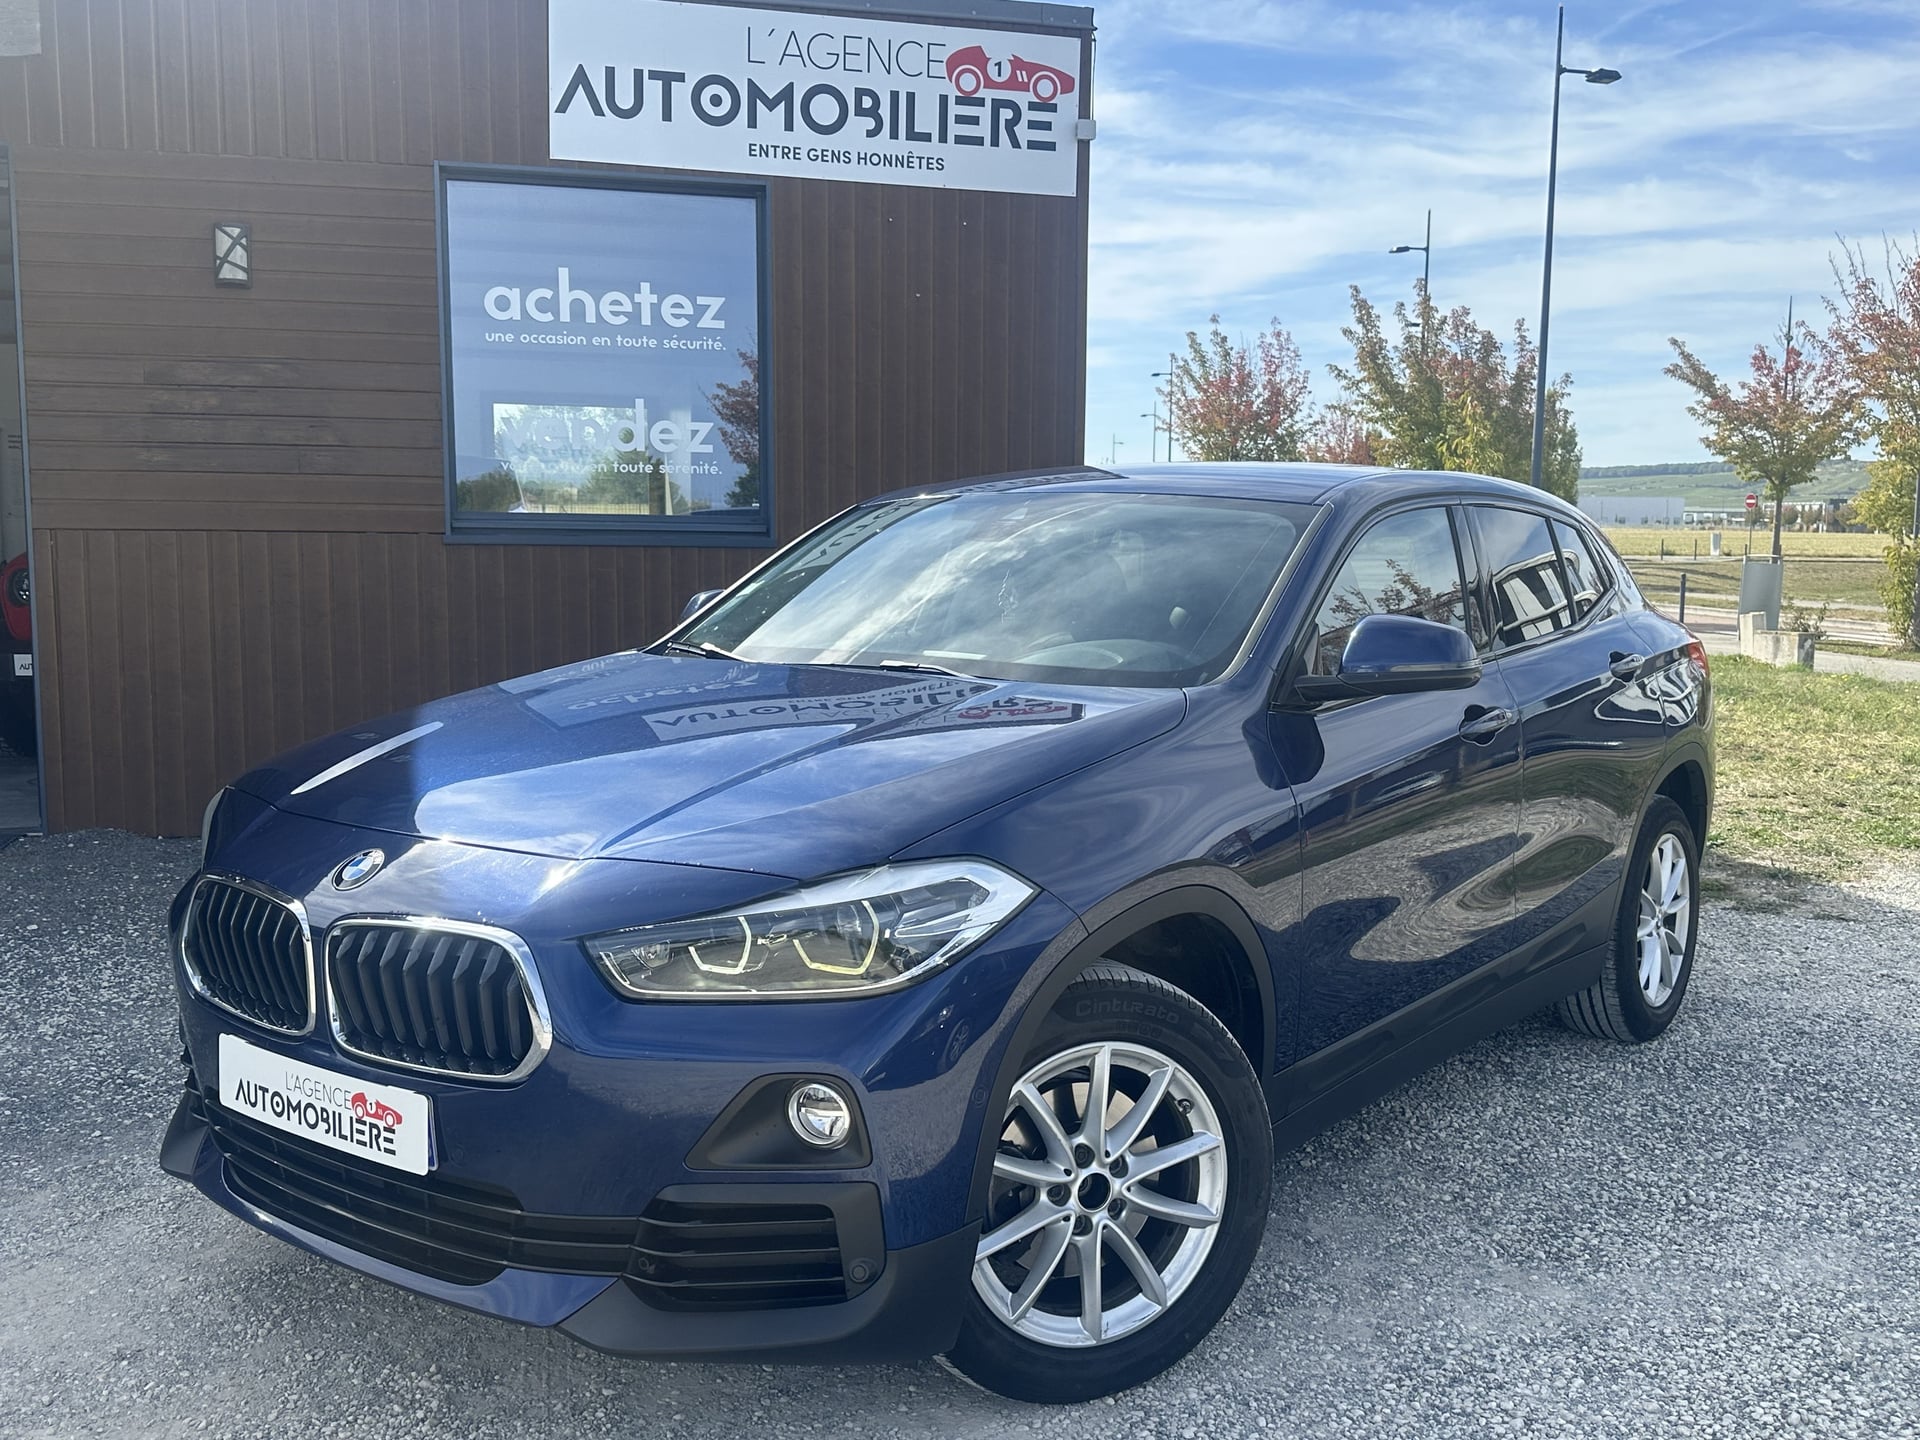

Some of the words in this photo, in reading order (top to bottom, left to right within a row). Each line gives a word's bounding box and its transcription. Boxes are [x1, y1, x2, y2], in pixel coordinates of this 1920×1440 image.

[747, 26, 946, 79] L'AGENCE
[748, 142, 801, 161] ENTRE
[807, 147, 852, 164] GENS
[857, 150, 945, 171] HONNÊTES
[483, 266, 726, 329] achetez
[485, 331, 514, 343] une
[520, 330, 587, 345] occasion
[592, 335, 611, 346] en
[616, 334, 658, 348] toute
[663, 335, 727, 351] sécurité.
[500, 398, 714, 453] vendez
[613, 460, 654, 473] toute
[1075, 1000, 1180, 1024] Cinturato
[285, 1071, 352, 1110] L'AGENCE
